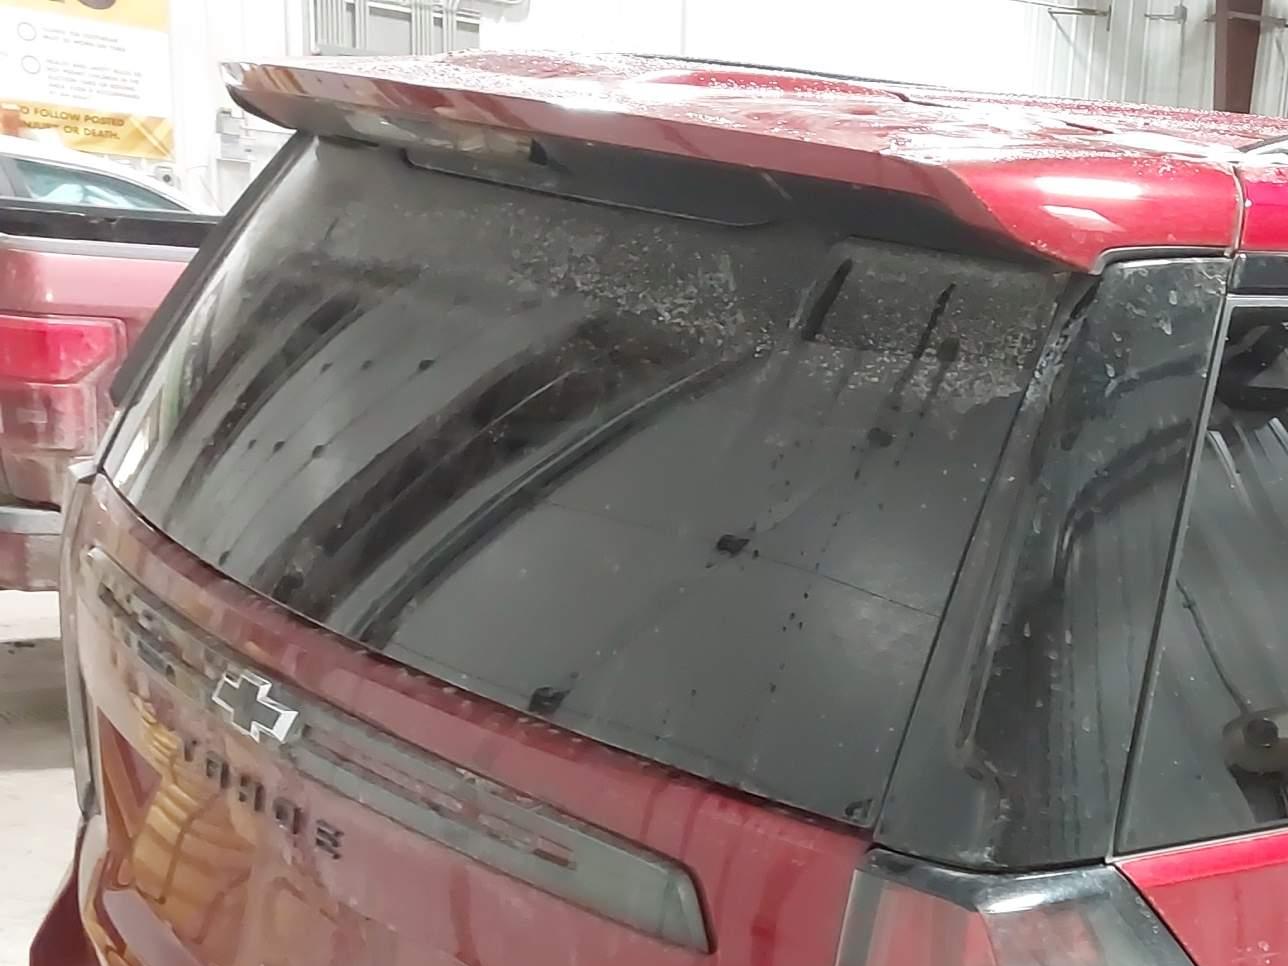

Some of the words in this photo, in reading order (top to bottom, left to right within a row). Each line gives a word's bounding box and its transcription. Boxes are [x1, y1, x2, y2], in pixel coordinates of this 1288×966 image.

[34, 108, 81, 122] FOLLOW
[84, 114, 125, 127] POSTED
[63, 125, 80, 135] OR
